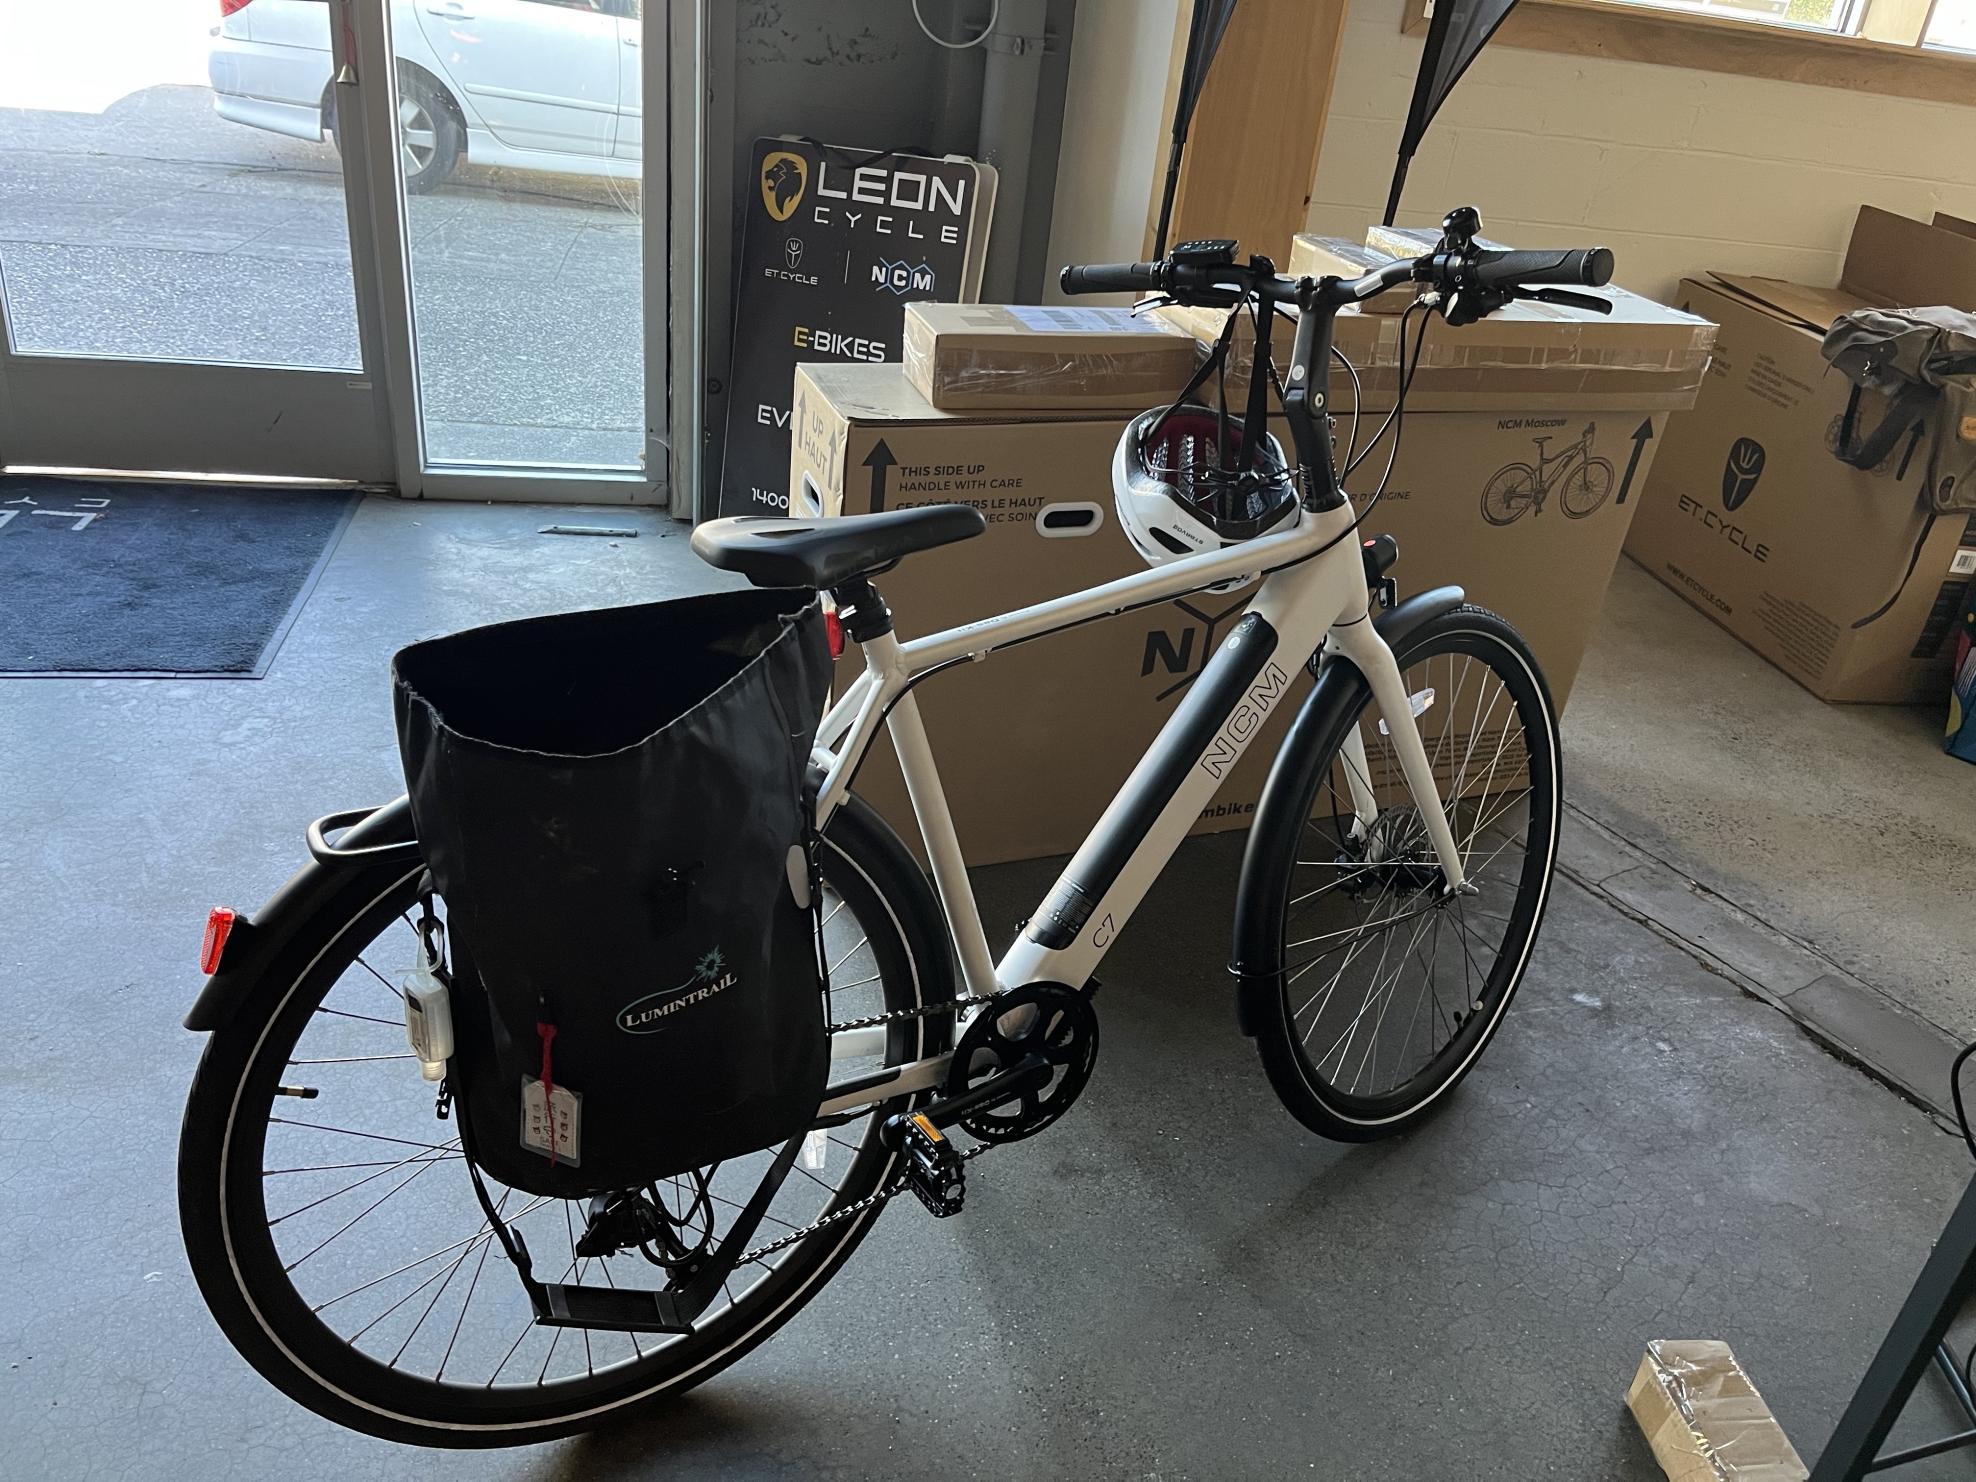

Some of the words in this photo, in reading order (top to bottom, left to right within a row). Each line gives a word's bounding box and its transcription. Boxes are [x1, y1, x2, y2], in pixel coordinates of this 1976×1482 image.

[817, 162, 965, 216] LEON
[814, 207, 958, 244] CYCLE
[871, 265, 932, 291] NCM
[793, 326, 886, 363] E-BIKES
[812, 410, 824, 438] UP
[1497, 418, 1523, 431] NCM
[804, 431, 828, 475] HAUT
[900, 466, 931, 478] THIS
[933, 465, 964, 477] SIDE
[967, 464, 985, 475] UP
[752, 487, 789, 510] 1400
[899, 481, 950, 492] HANDLE
[955, 480, 986, 490] WITH
[990, 478, 1023, 489] CARE
[991, 498, 1006, 509] LE
[1009, 496, 1045, 508] HAUT
[1008, 511, 1037, 522] SOIN
[1200, 662, 1288, 780] NCM
[1093, 912, 1115, 948] C7
